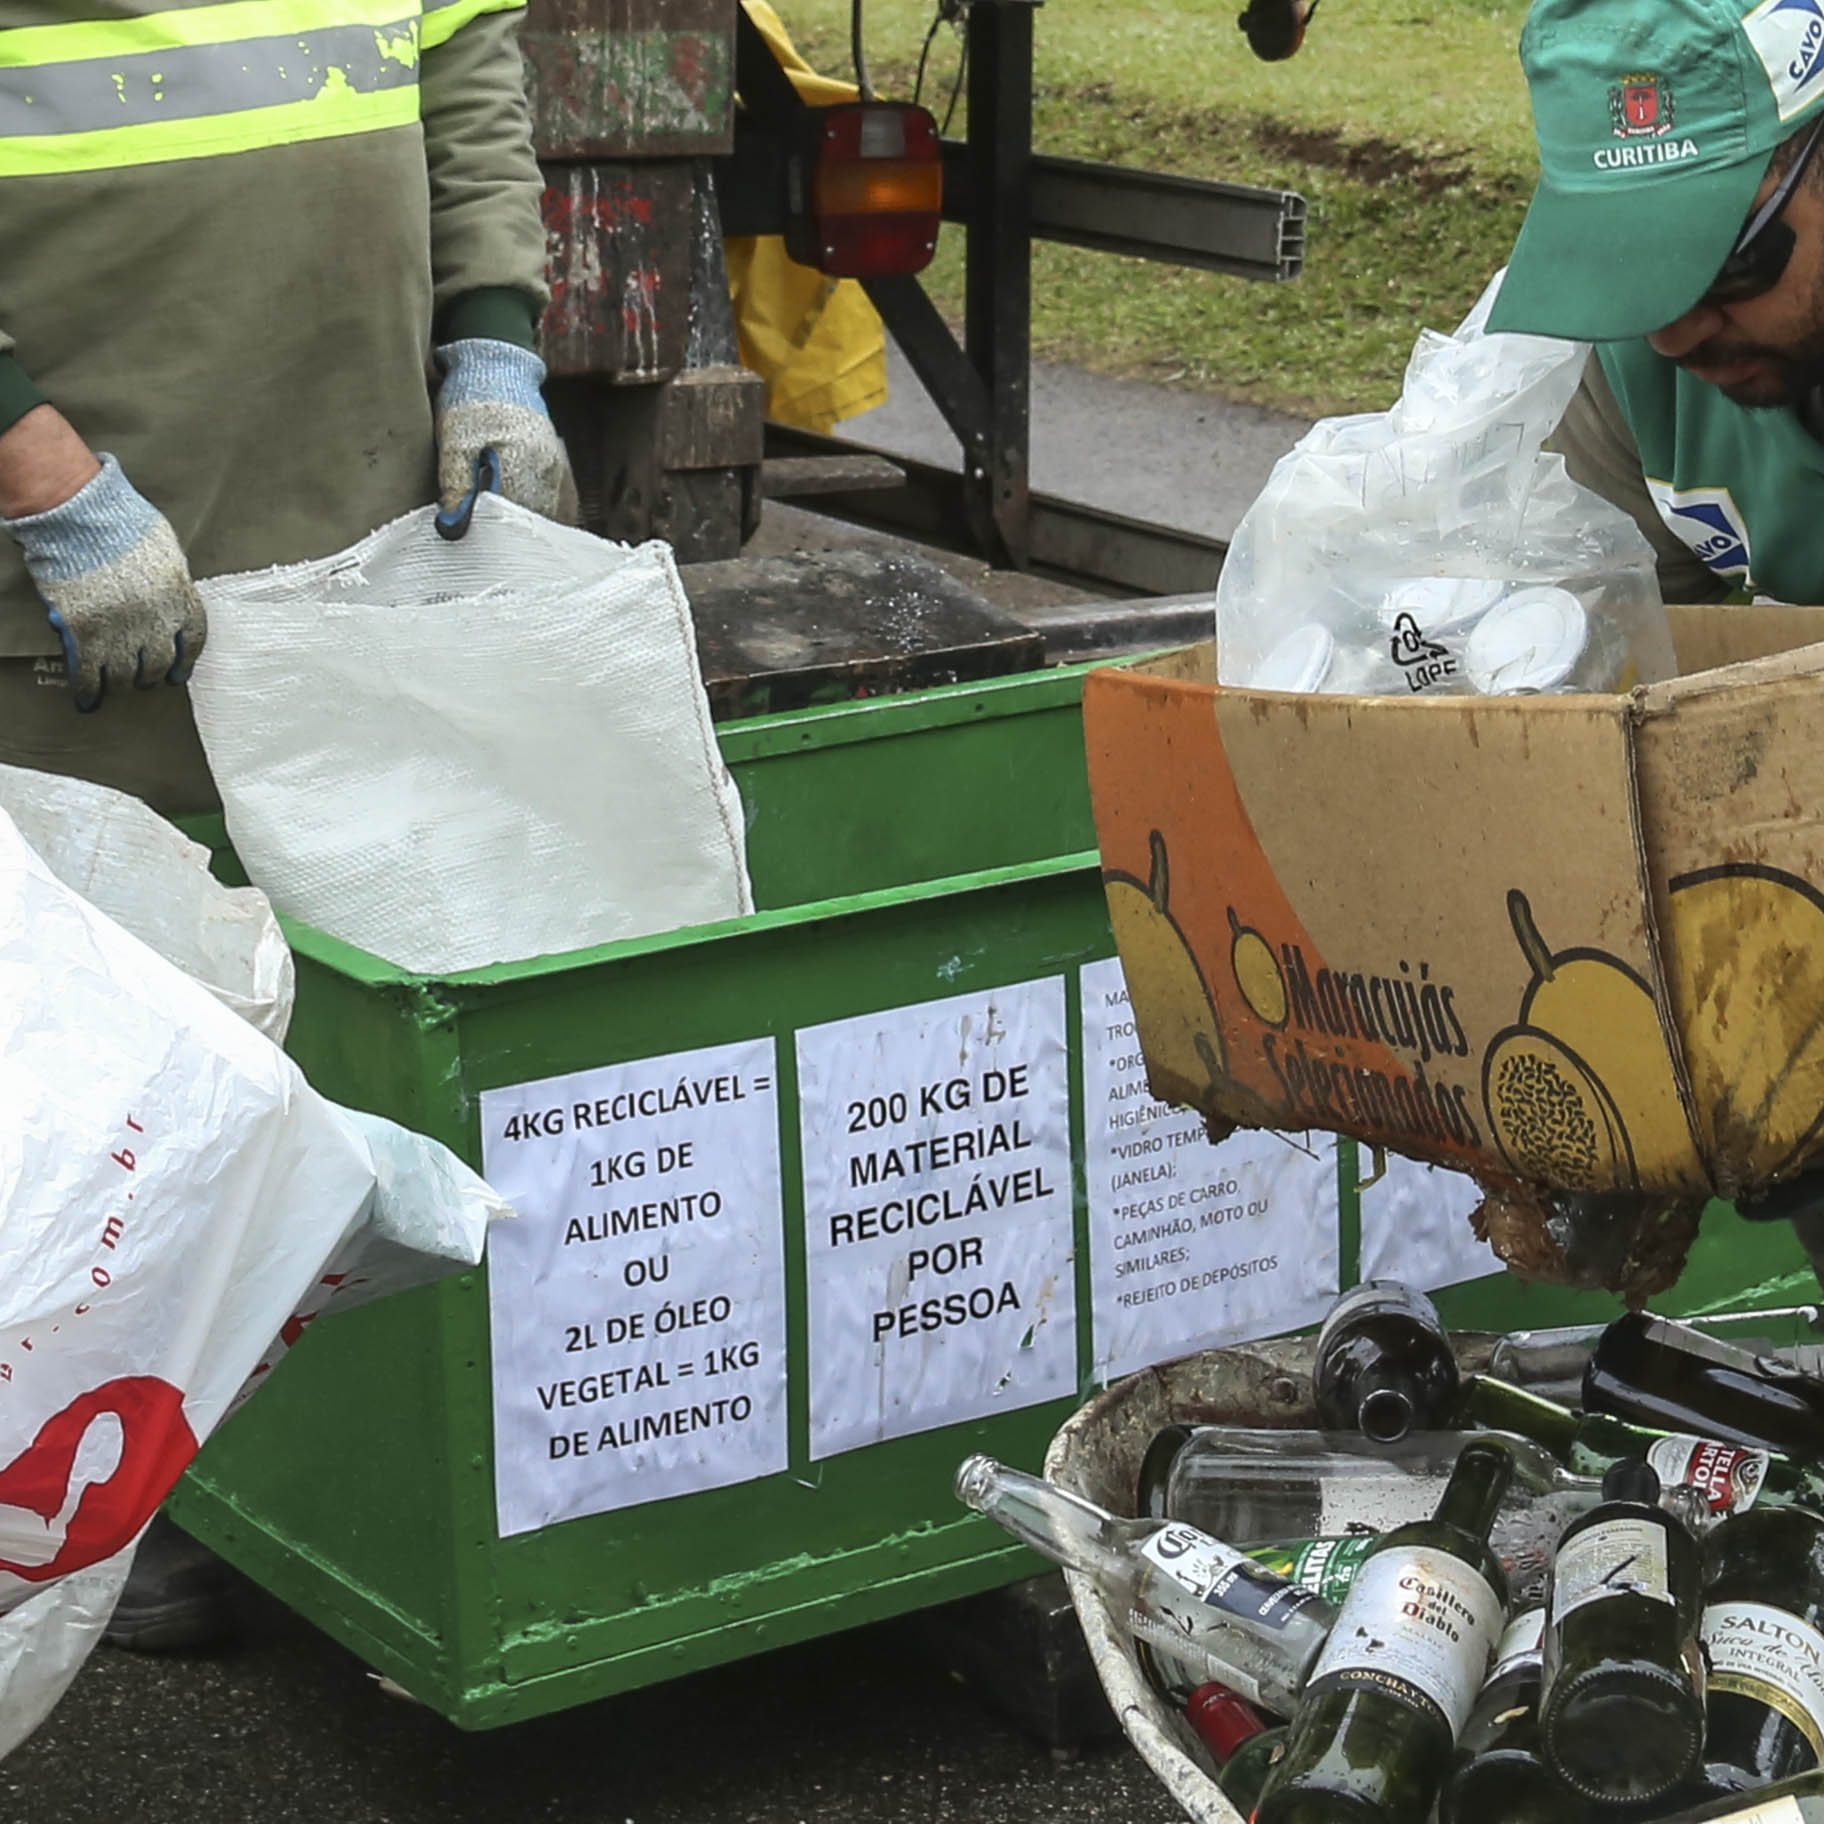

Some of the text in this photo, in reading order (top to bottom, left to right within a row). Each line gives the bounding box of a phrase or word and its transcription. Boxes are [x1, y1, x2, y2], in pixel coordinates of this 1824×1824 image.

[1788, 19, 1822, 80] CAVO
[1593, 138, 1698, 170] CURITIBA
[1695, 535, 1732, 559] AVO
[1105, 992, 1130, 1008] MA
[1281, 943, 1468, 1062] Maracujás
[1107, 1022, 1136, 1041] TRO
[1109, 1052, 1145, 1072] ORG
[504, 1108, 563, 1142] 4KG
[574, 1075, 746, 1130] RECICLÁVEL
[847, 1064, 1029, 1133] 200 KG DE
[1108, 1080, 1151, 1103] ALIME
[1263, 1033, 1482, 1149] Selecionados
[850, 1120, 1032, 1188] MATERIAL
[1166, 1126, 1208, 1149] TEMP
[589, 1142, 694, 1187] 1KG DE
[1111, 1164, 1177, 1194] (JANELA);
[564, 1191, 722, 1245] ALIMENTO
[830, 1167, 1054, 1247] RECICLÁVEL
[1168, 1191, 1186, 1209] DE
[1113, 1198, 1268, 1251] CAMINHÃO, MOTO OU
[623, 1255, 669, 1287] OU
[908, 1236, 983, 1282] POR
[1114, 1247, 1190, 1278] SIMILARES;
[1180, 1275, 1200, 1293] DE
[1202, 1255, 1278, 1289] DEPÓSITOS
[565, 1295, 731, 1353] 2L DE ÓLEO
[872, 1281, 1020, 1343] PESSOA
[537, 1362, 670, 1411] VEGETAL
[703, 1342, 760, 1376] 1KG
[548, 1395, 752, 1460] DE ALIMENTO
[1692, 1440, 1725, 1489] ARTOI
[1708, 1449, 1736, 1501] TELLA
[1303, 1540, 1336, 1594] ELITAS
[1399, 1576, 1475, 1627] Casillero
[1401, 1601, 1460, 1643] Diablo
[1428, 1600, 1447, 1616] del
[1721, 1616, 1821, 1665] SALTON
[1763, 1644, 1787, 1657] de
[1730, 1647, 1801, 1682] INTEGRAL
